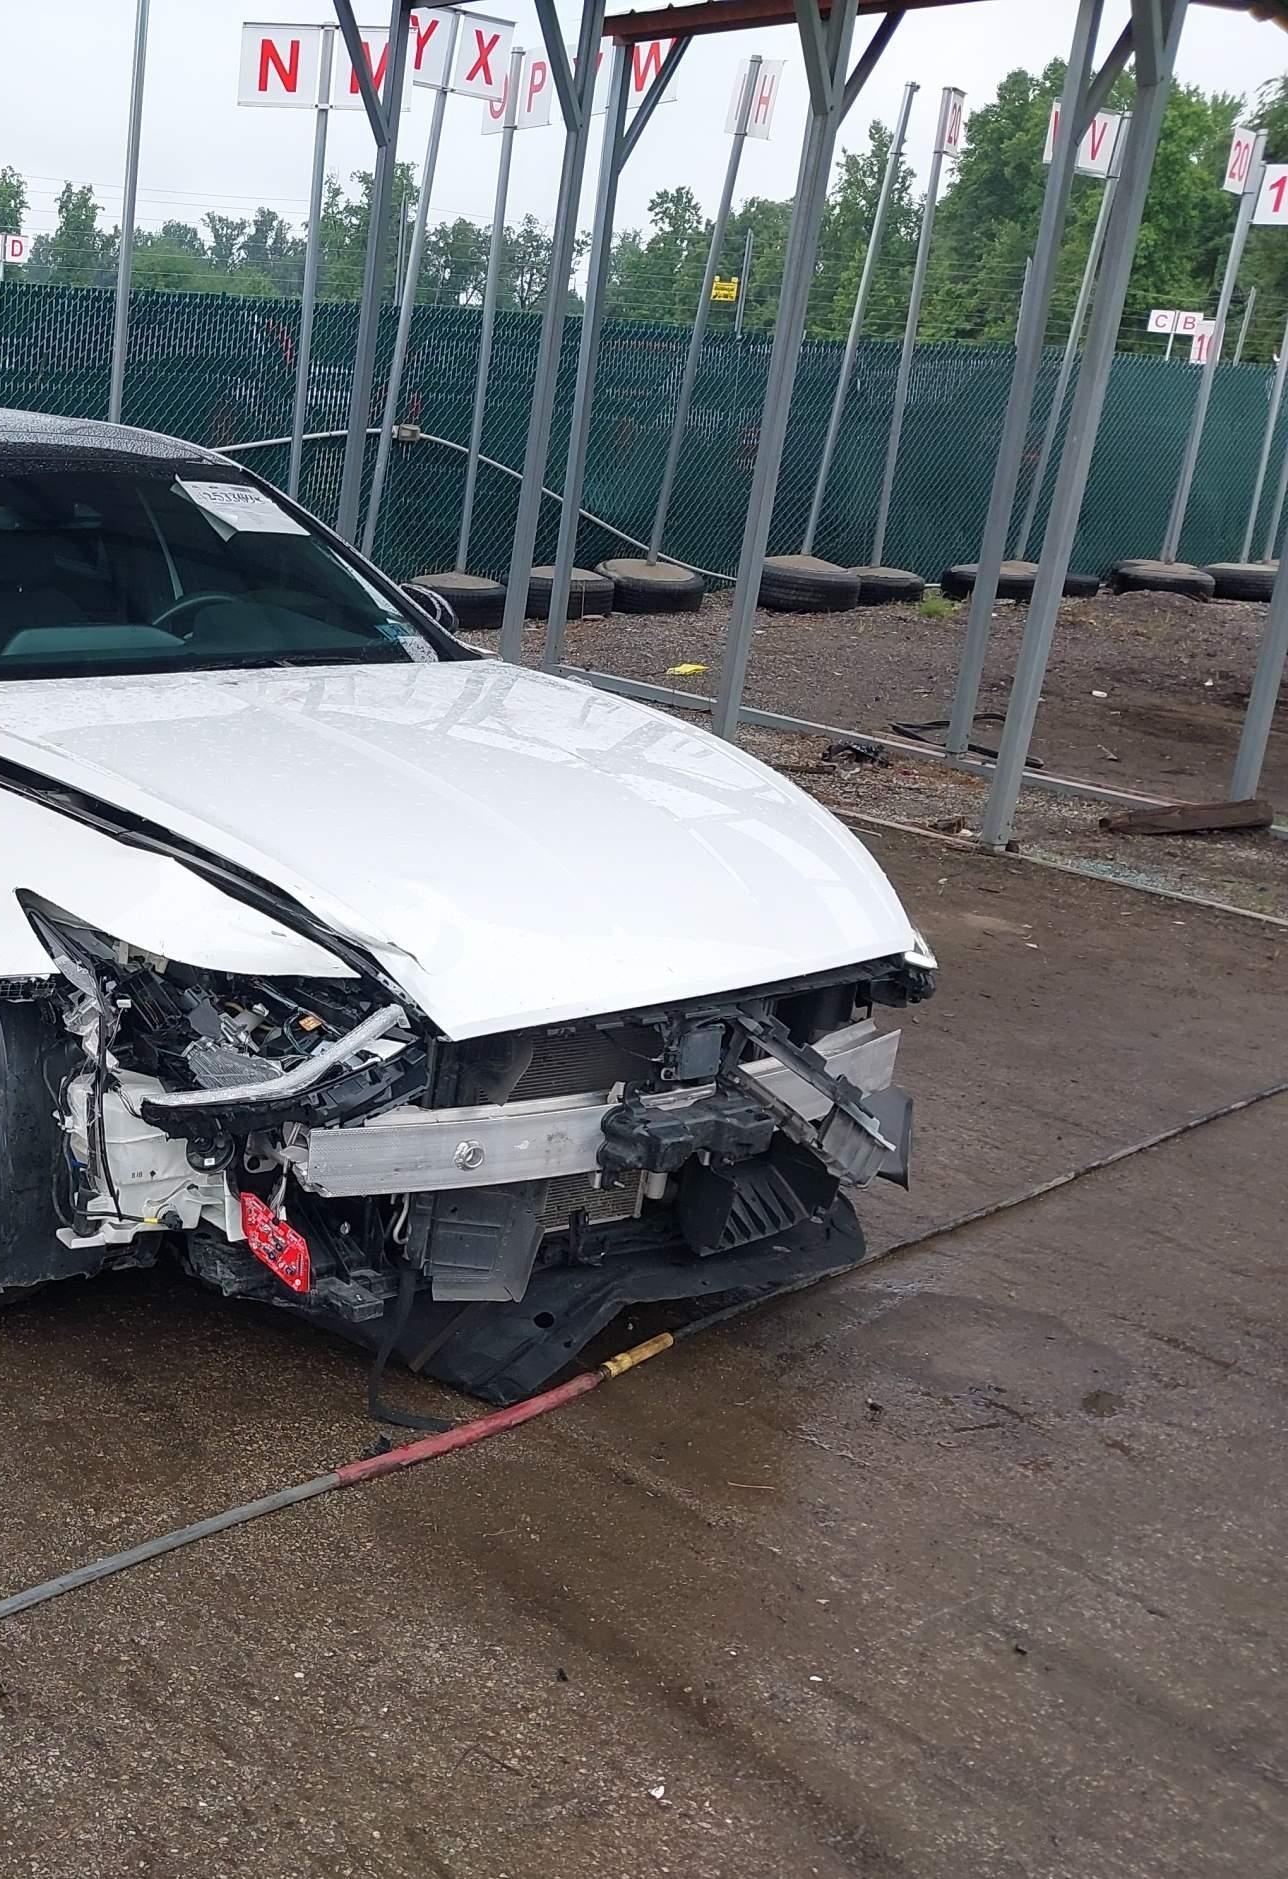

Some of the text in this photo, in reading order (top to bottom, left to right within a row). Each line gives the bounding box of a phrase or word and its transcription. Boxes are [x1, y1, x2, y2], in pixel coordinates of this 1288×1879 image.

[258, 38, 300, 93] N
[409, 15, 501, 86] Y X
[527, 61, 548, 113] P
[755, 74, 776, 124] H
[947, 102, 963, 147] 20
[1091, 119, 1108, 161] V
[1228, 140, 1251, 182] 20
[11, 239, 24, 257] D
[1154, 314, 1196, 330] C B
